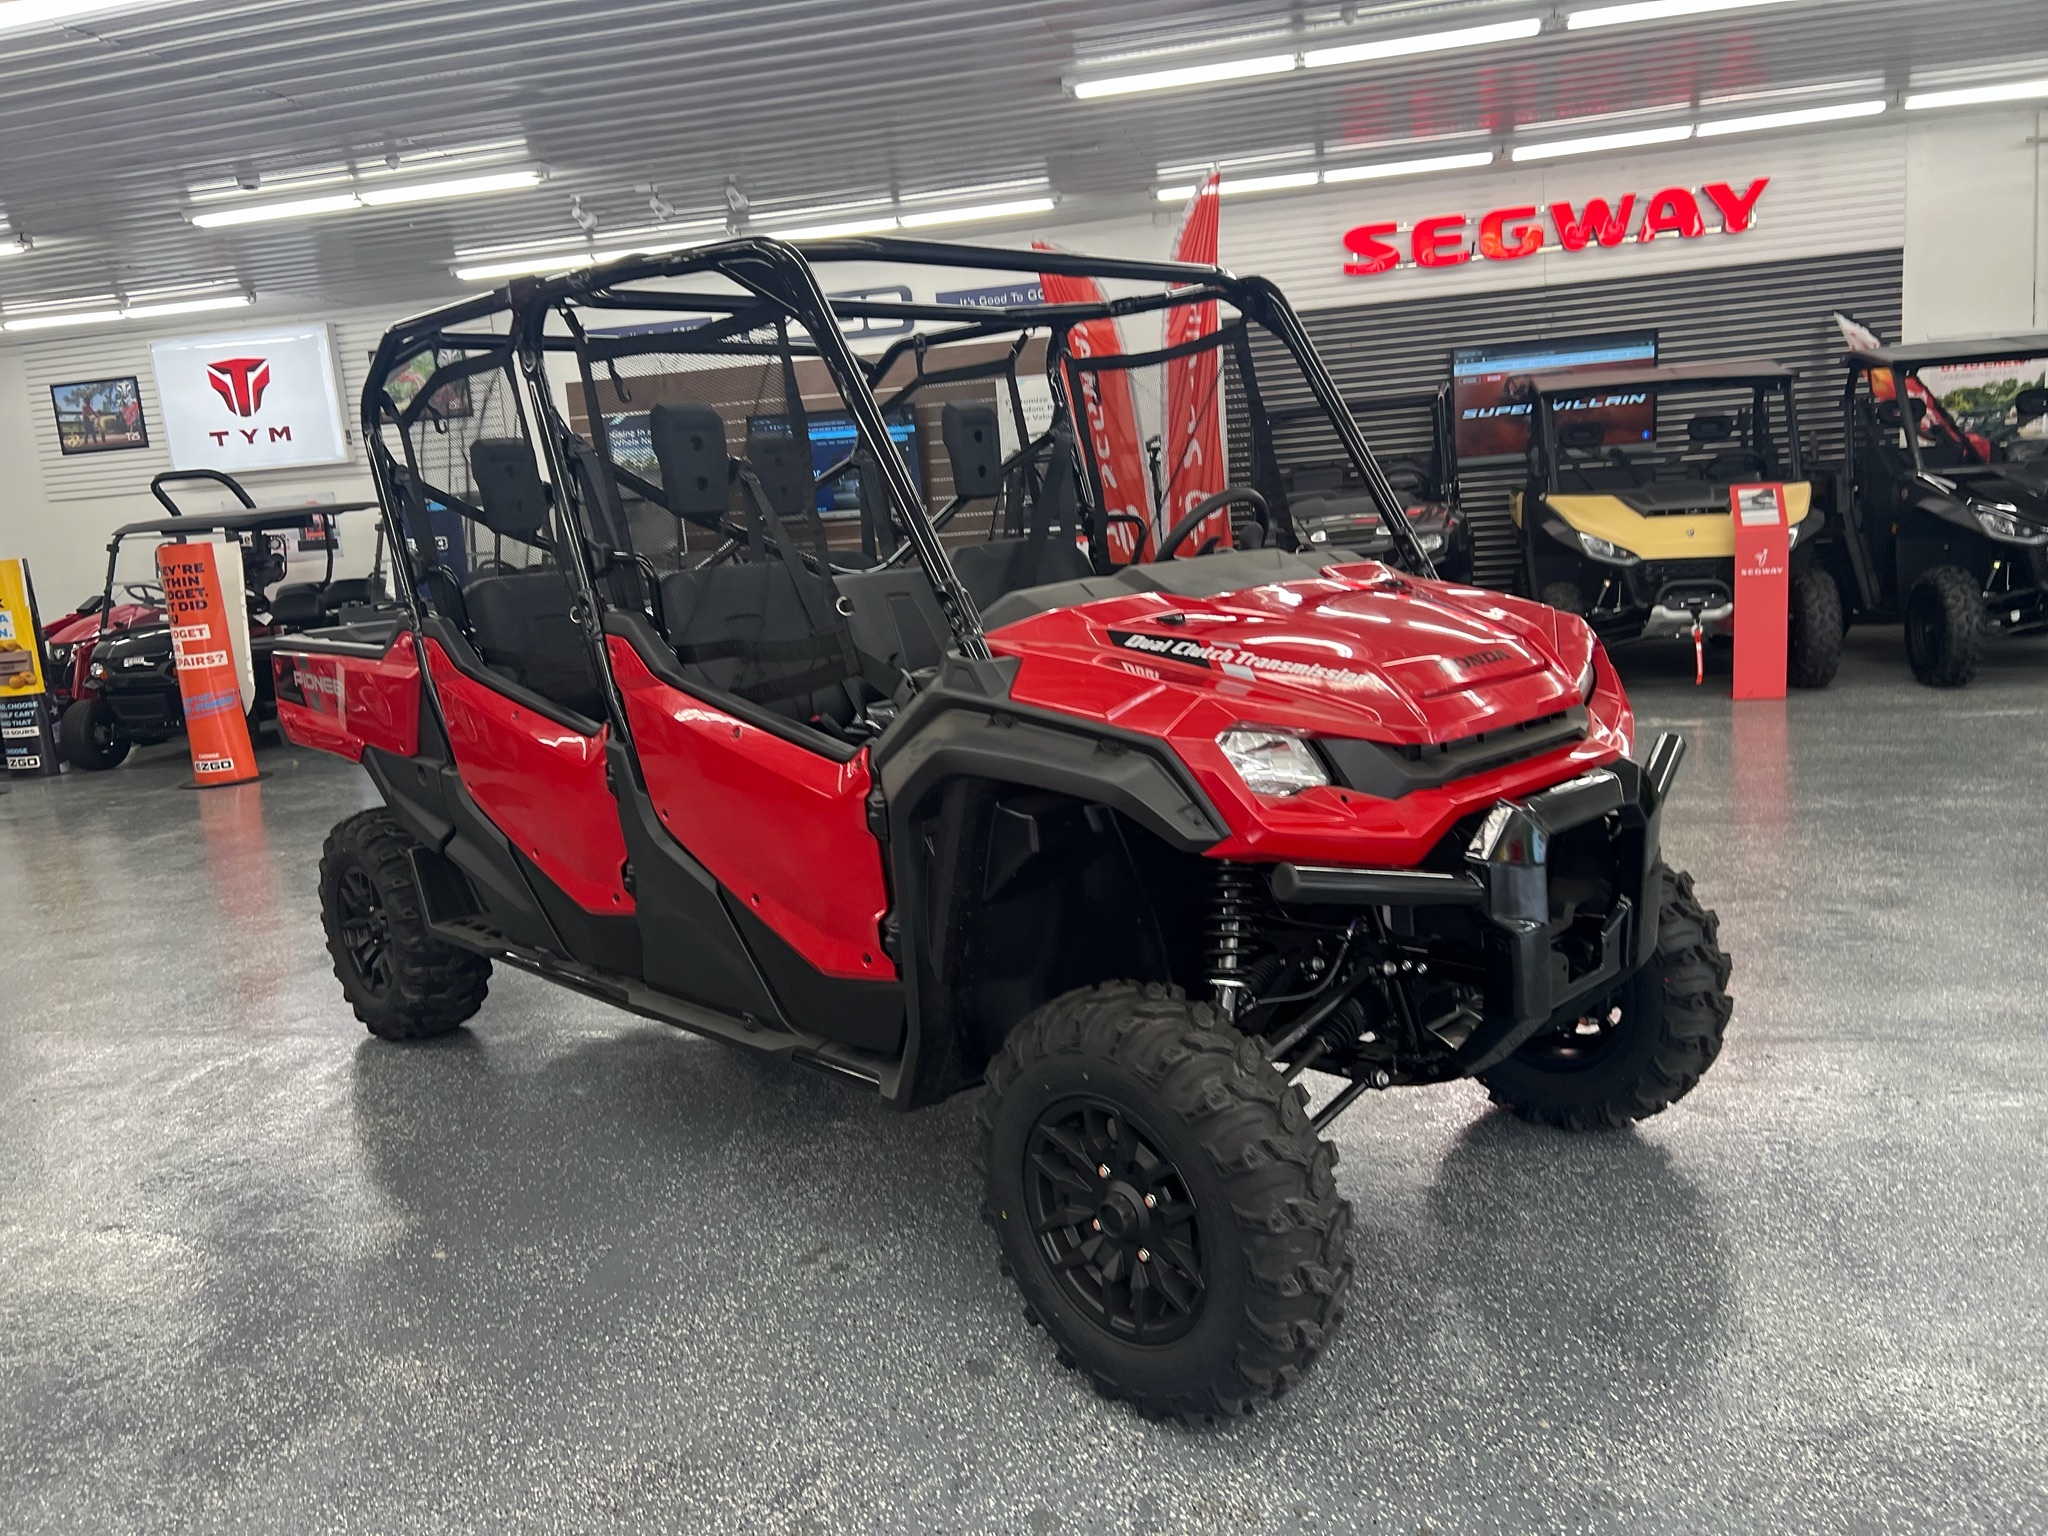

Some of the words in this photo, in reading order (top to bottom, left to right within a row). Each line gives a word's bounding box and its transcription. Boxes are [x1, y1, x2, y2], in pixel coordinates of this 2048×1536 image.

[1344, 177, 1770, 276] SEGWAY
[979, 293, 1007, 306] Good
[1010, 292, 1024, 303] To
[1552, 393, 1647, 412] VILLAIN
[209, 426, 292, 447] TYM
[178, 601, 208, 612] DID
[1124, 633, 1173, 653] Dual
[1170, 641, 1234, 664] Clutch
[1233, 649, 1370, 687] Transmission
